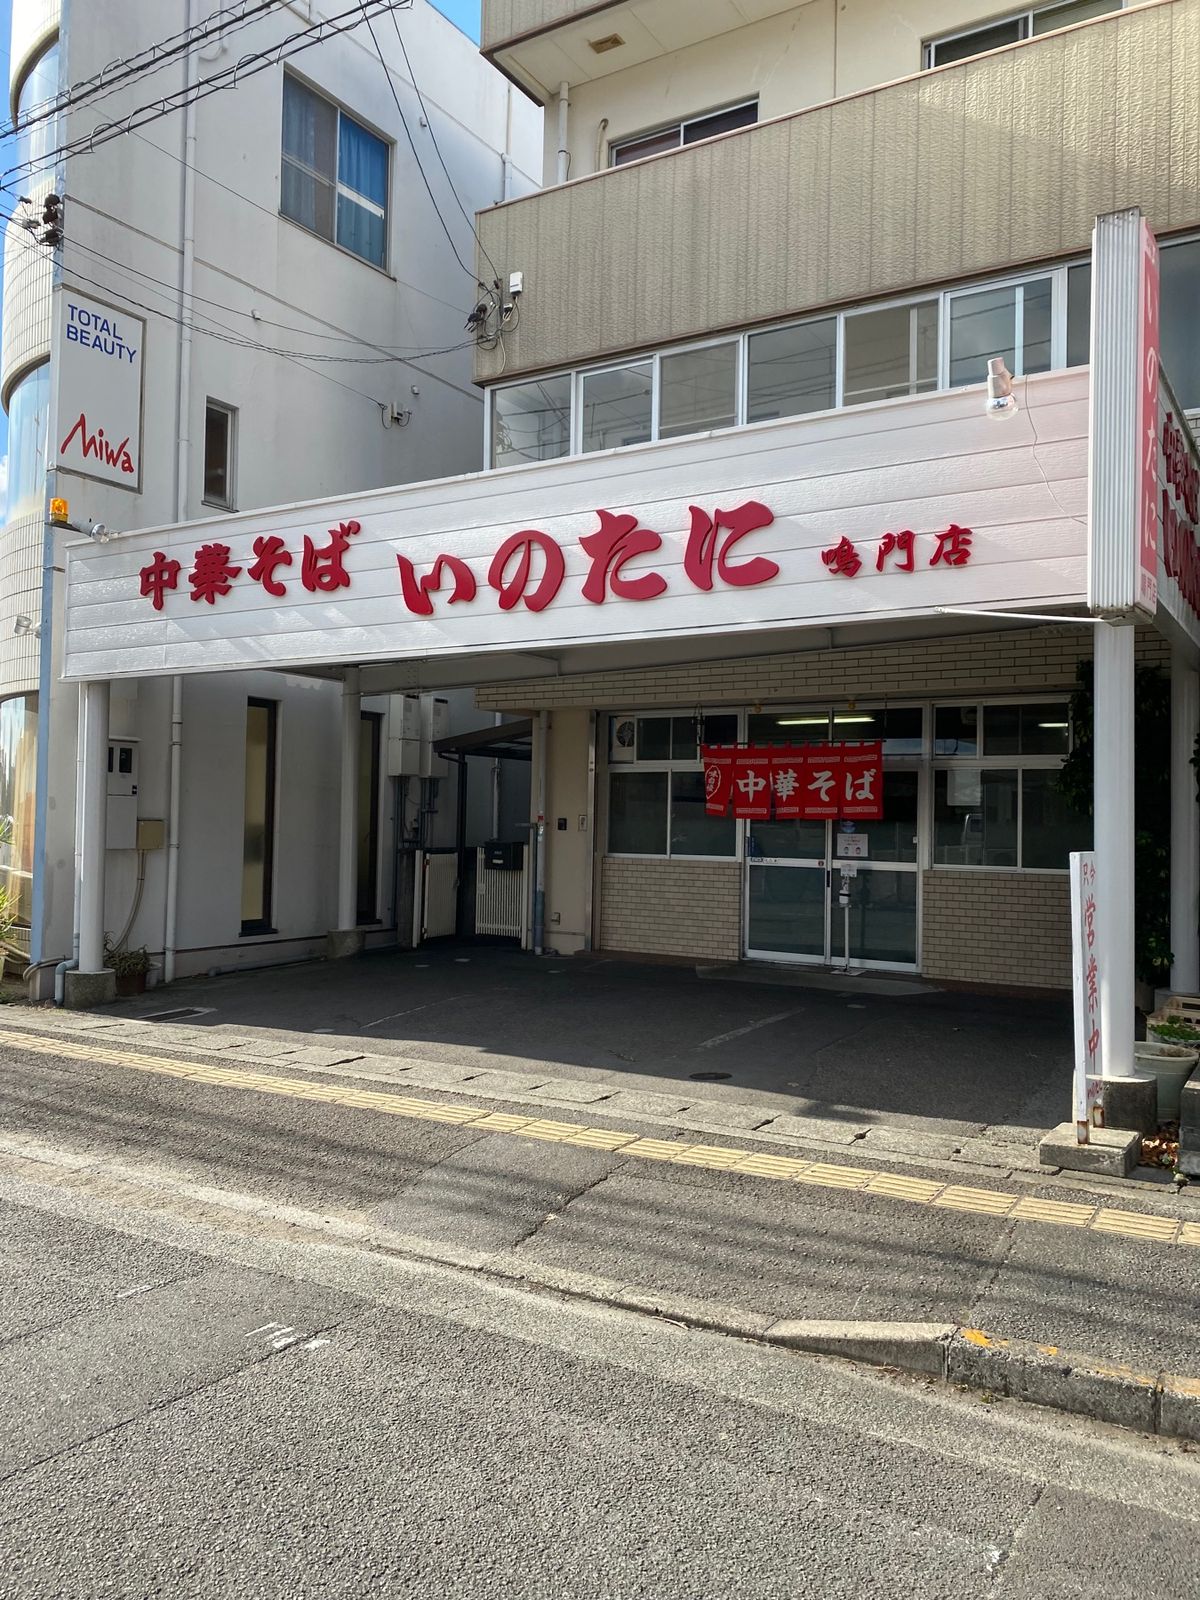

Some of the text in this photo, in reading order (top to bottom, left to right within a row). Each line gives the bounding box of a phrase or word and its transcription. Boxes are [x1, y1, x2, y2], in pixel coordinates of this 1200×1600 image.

[66, 324, 137, 364] BEAUTY
[67, 304, 123, 341] TOTAL
[60, 413, 134, 473] Miwa
[139, 500, 973, 616] 中華そば いのたに 鳴門店
[736, 768, 877, 803] 中華そば
[1084, 893, 1100, 1075] 営業中
